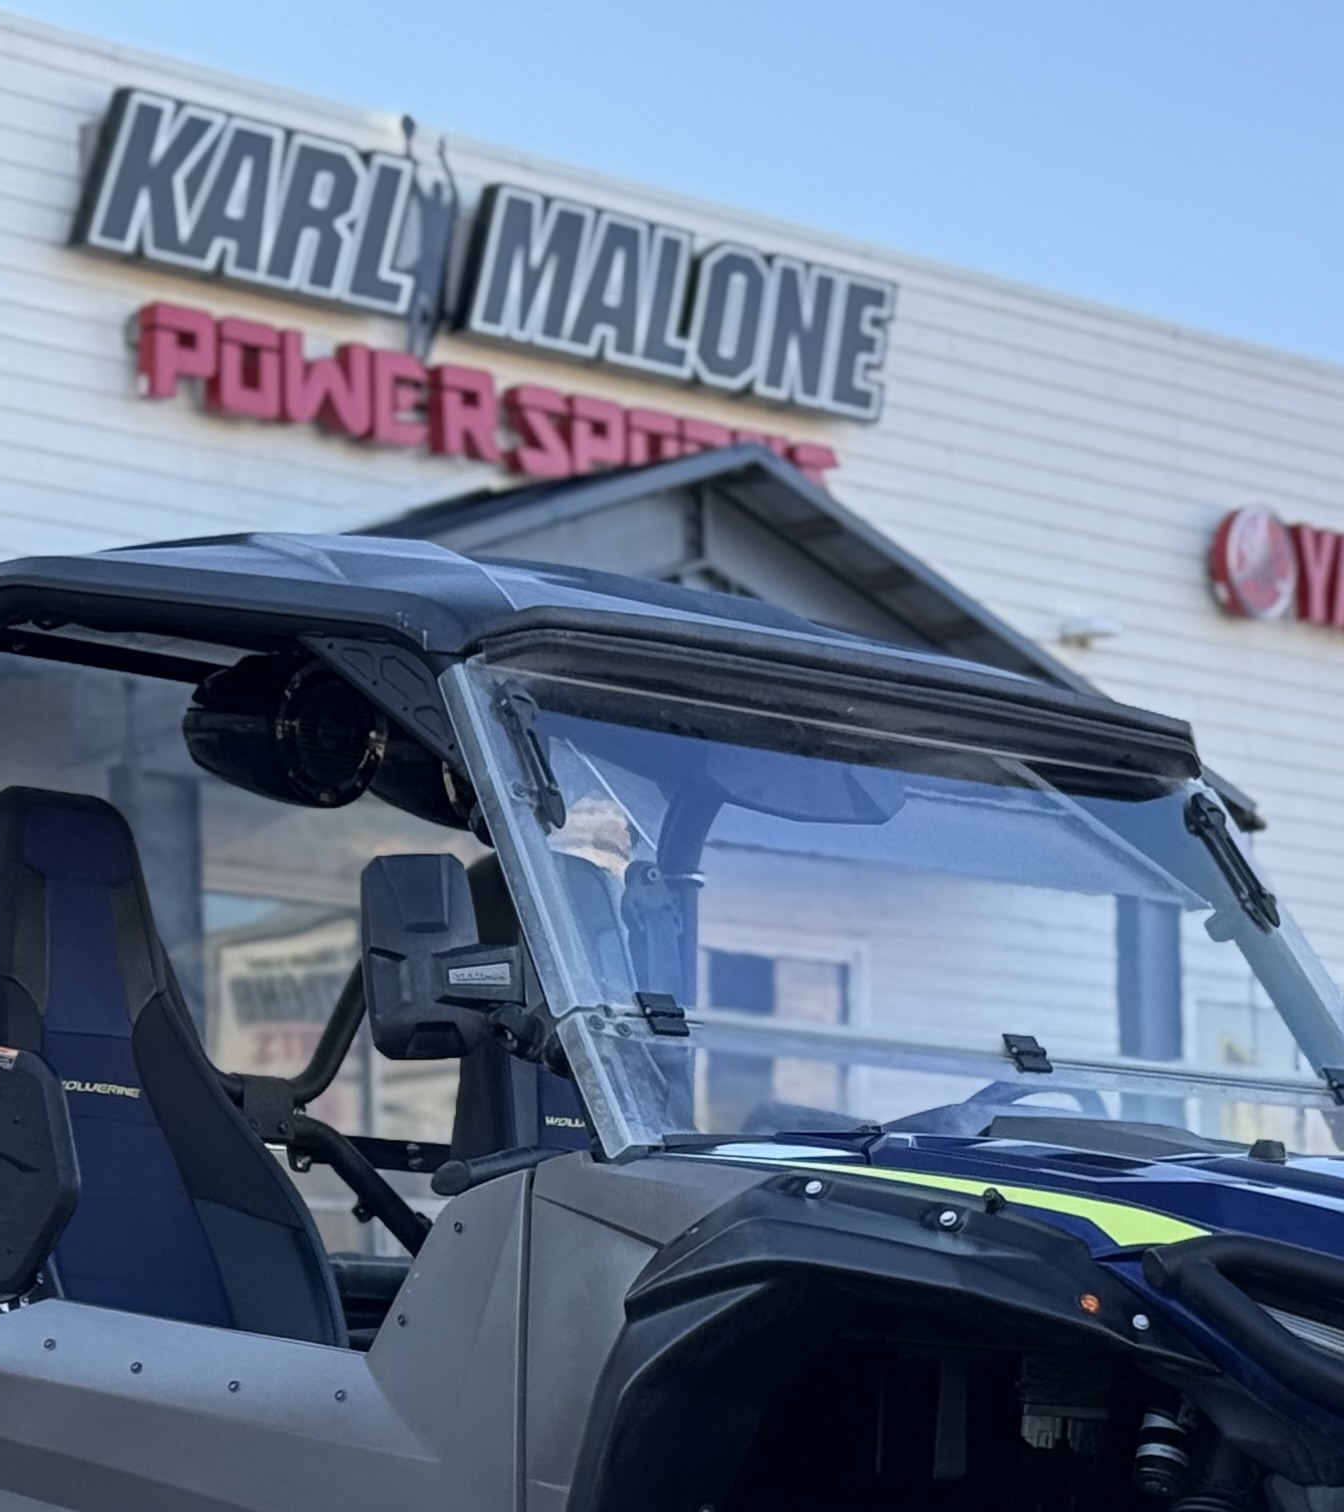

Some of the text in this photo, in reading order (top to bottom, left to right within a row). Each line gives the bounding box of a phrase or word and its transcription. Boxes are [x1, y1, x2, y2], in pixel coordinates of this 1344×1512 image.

[86, 90, 898, 421] KARL MALONE
[136, 301, 839, 488] POWERSPO
